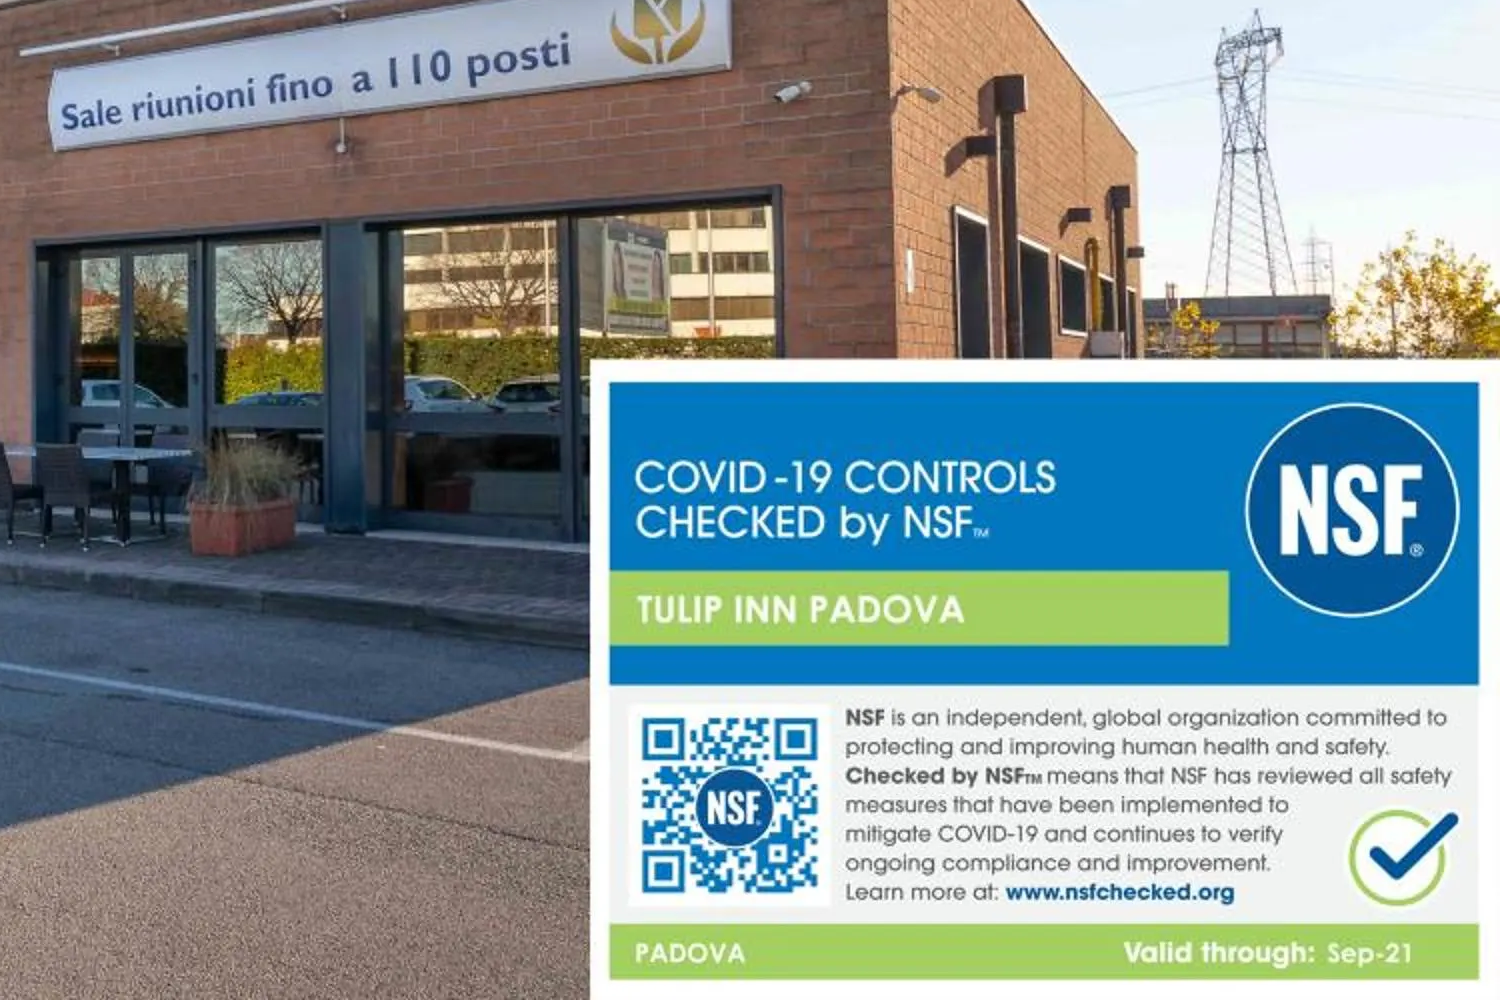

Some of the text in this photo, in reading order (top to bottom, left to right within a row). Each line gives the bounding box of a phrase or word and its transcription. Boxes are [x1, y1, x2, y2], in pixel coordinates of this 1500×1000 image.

[61, 33, 572, 131] Sale riunioni fino a 110 posti
